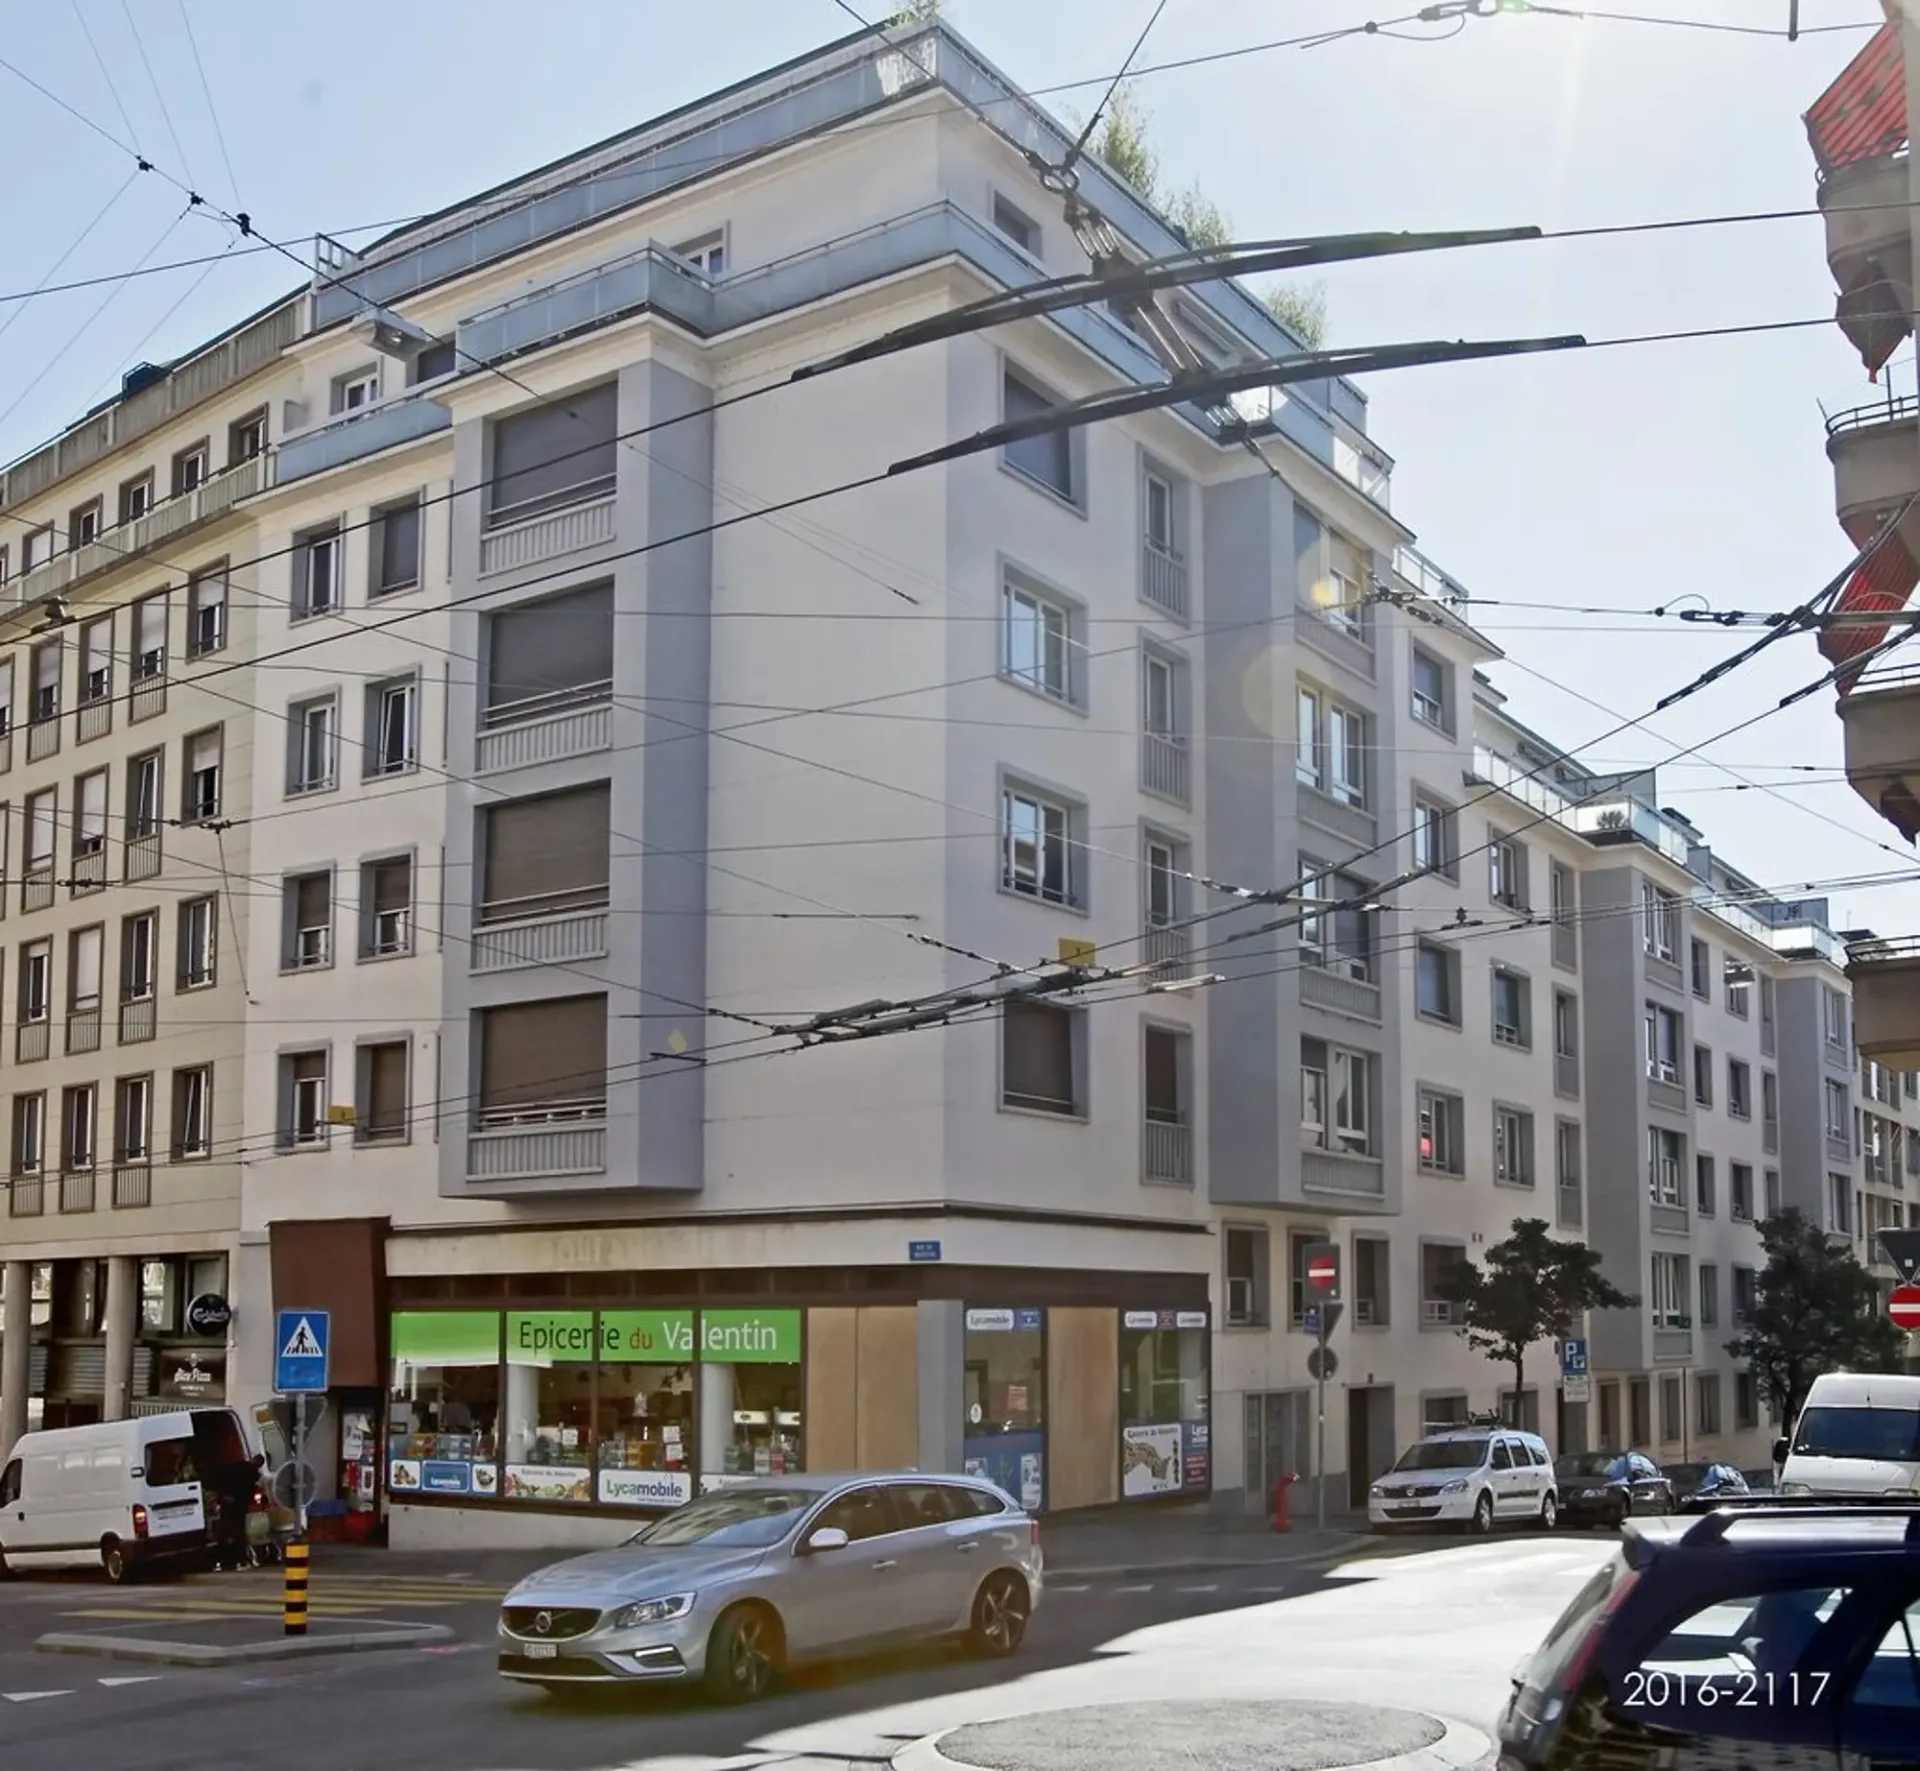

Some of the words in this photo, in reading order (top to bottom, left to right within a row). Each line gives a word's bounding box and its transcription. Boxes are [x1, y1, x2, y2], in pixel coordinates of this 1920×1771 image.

[519, 1320, 621, 1359] Epicerie
[628, 1327, 654, 1350] du
[662, 1318, 778, 1351] Valentin
[1565, 1342, 1577, 1362] P
[605, 1479, 684, 1498] Lycamobile
